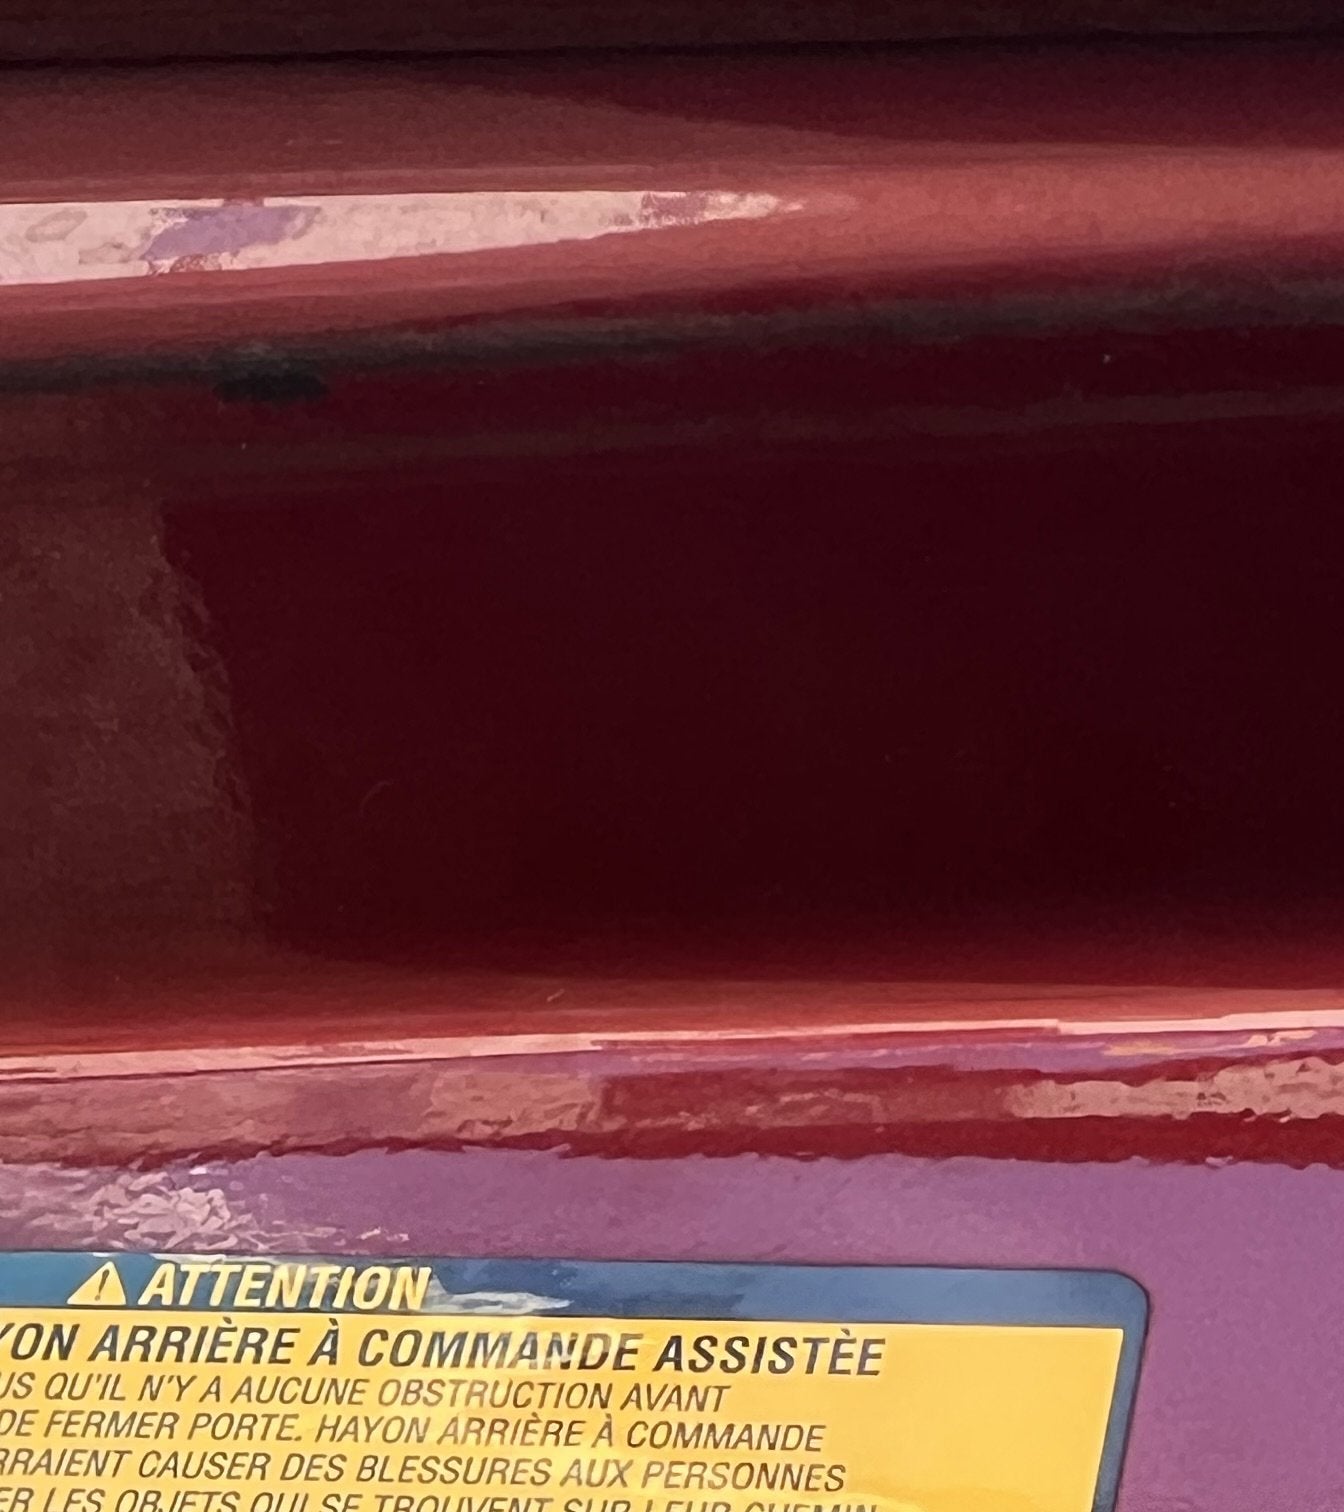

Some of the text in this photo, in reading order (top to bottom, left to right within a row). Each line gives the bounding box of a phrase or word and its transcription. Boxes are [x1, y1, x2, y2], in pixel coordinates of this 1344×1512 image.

[138, 1263, 432, 1311] ATTENTION
[88, 1317, 301, 1365] ARRIÈRE
[307, 1318, 339, 1366] À
[358, 1328, 644, 1371] COMMANDE
[44, 1372, 126, 1401] QU'IL
[137, 1374, 198, 1402] N'Y
[200, 1375, 222, 1403] A
[230, 1376, 370, 1405] AUCUNE
[378, 1378, 613, 1410] OBSTRUCTION
[620, 1384, 731, 1413] AVANT
[0, 1409, 39, 1438] DE
[43, 1410, 179, 1440] FERMER
[314, 1415, 431, 1444] HAYON
[437, 1413, 587, 1447] ARRIÈRE
[591, 1413, 614, 1449] À
[627, 1421, 827, 1452] COMMANDE
[138, 1451, 271, 1481] CAUSER
[280, 1453, 347, 1482] DES
[356, 1455, 552, 1486] BLESSURES
[559, 1458, 634, 1489] AUX
[641, 1461, 846, 1492] PERSONNES
